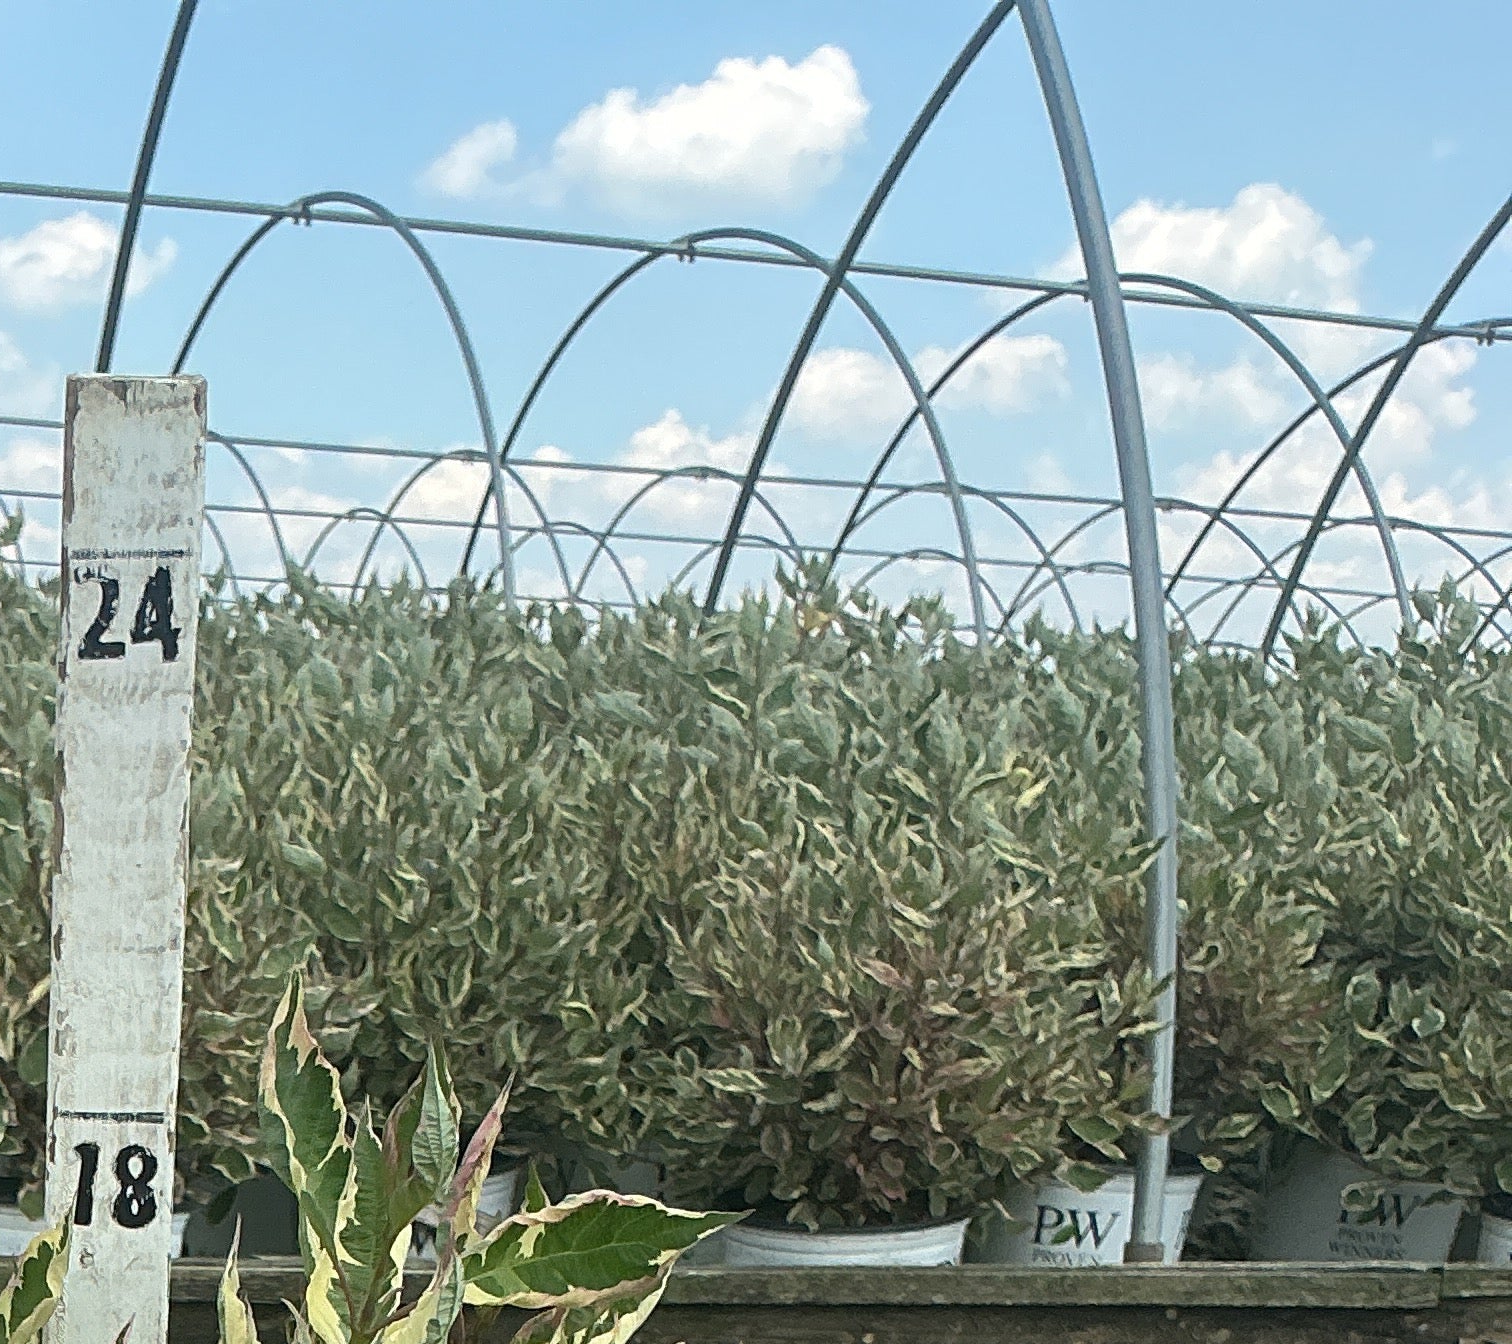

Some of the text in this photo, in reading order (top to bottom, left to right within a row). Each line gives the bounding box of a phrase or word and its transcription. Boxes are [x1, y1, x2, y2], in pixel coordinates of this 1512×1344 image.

[74, 566, 182, 661] 24
[73, 1143, 159, 1228] 18
[1034, 1204, 1120, 1250] PW
